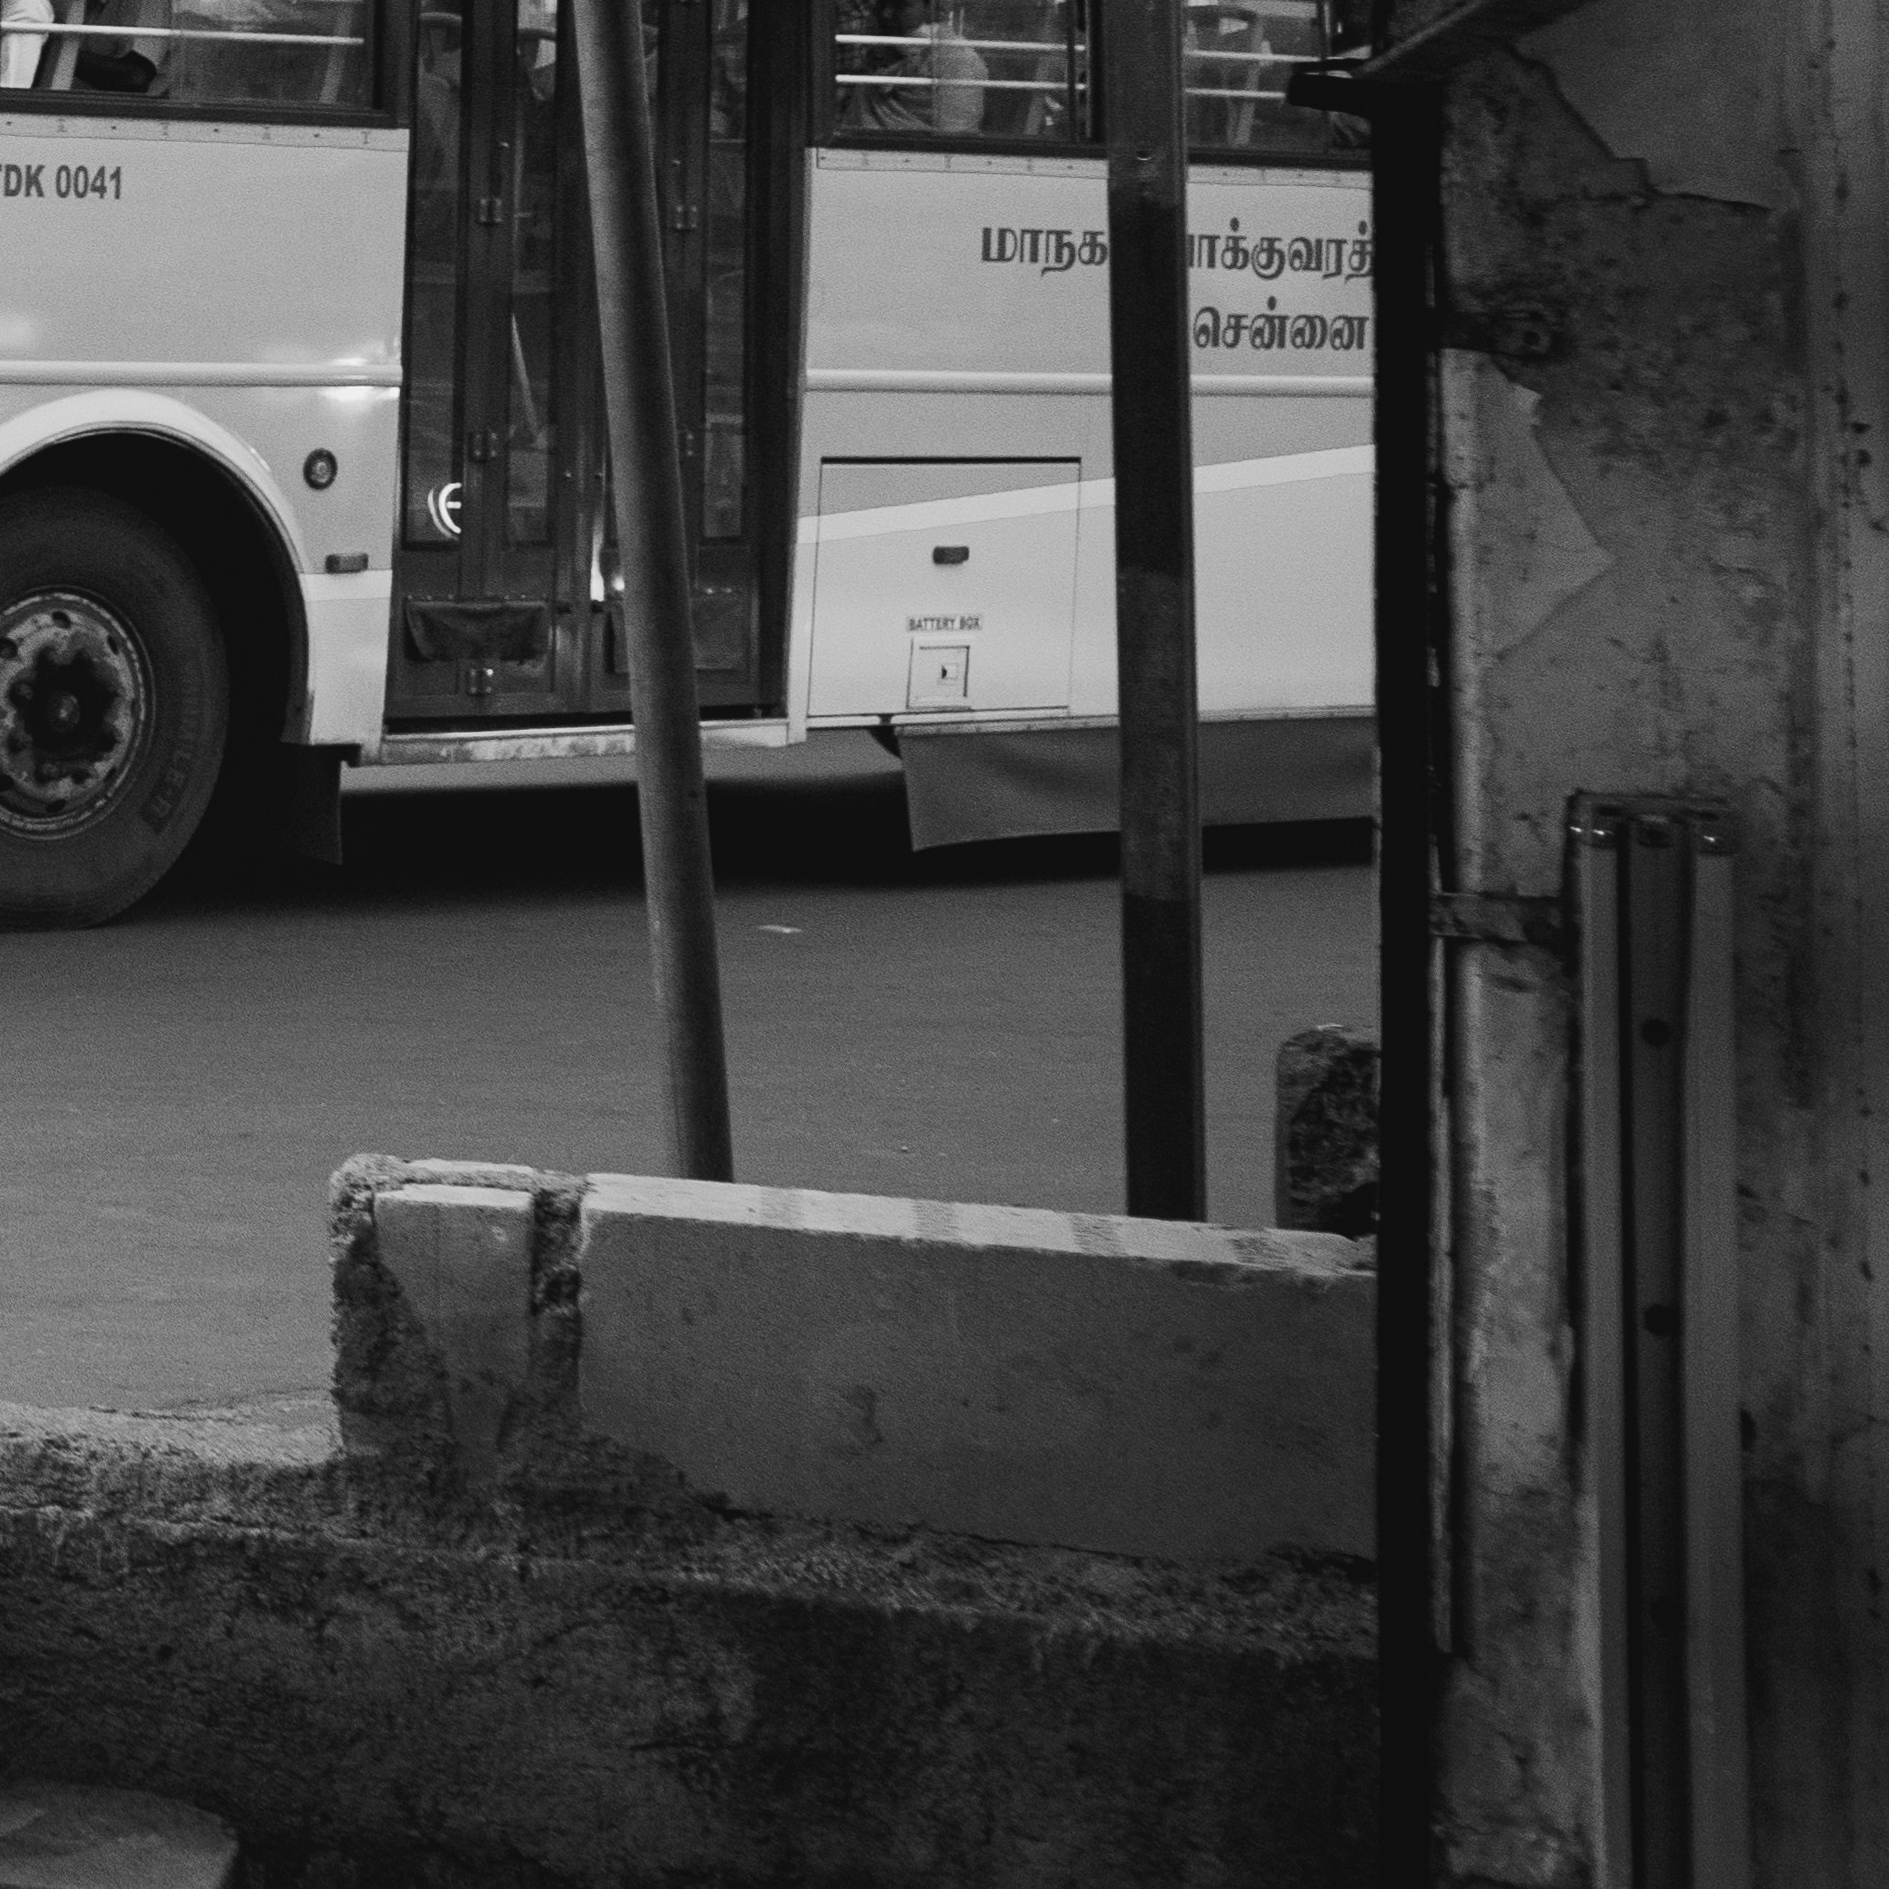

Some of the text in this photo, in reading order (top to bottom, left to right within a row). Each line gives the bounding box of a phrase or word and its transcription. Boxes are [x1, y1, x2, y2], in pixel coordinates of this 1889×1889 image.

[54, 164, 123, 202] 0041
[979, 225, 1110, 278] மாநக
[1193, 295, 1370, 351] சென்னை
[908, 616, 957, 631] BATTERY
